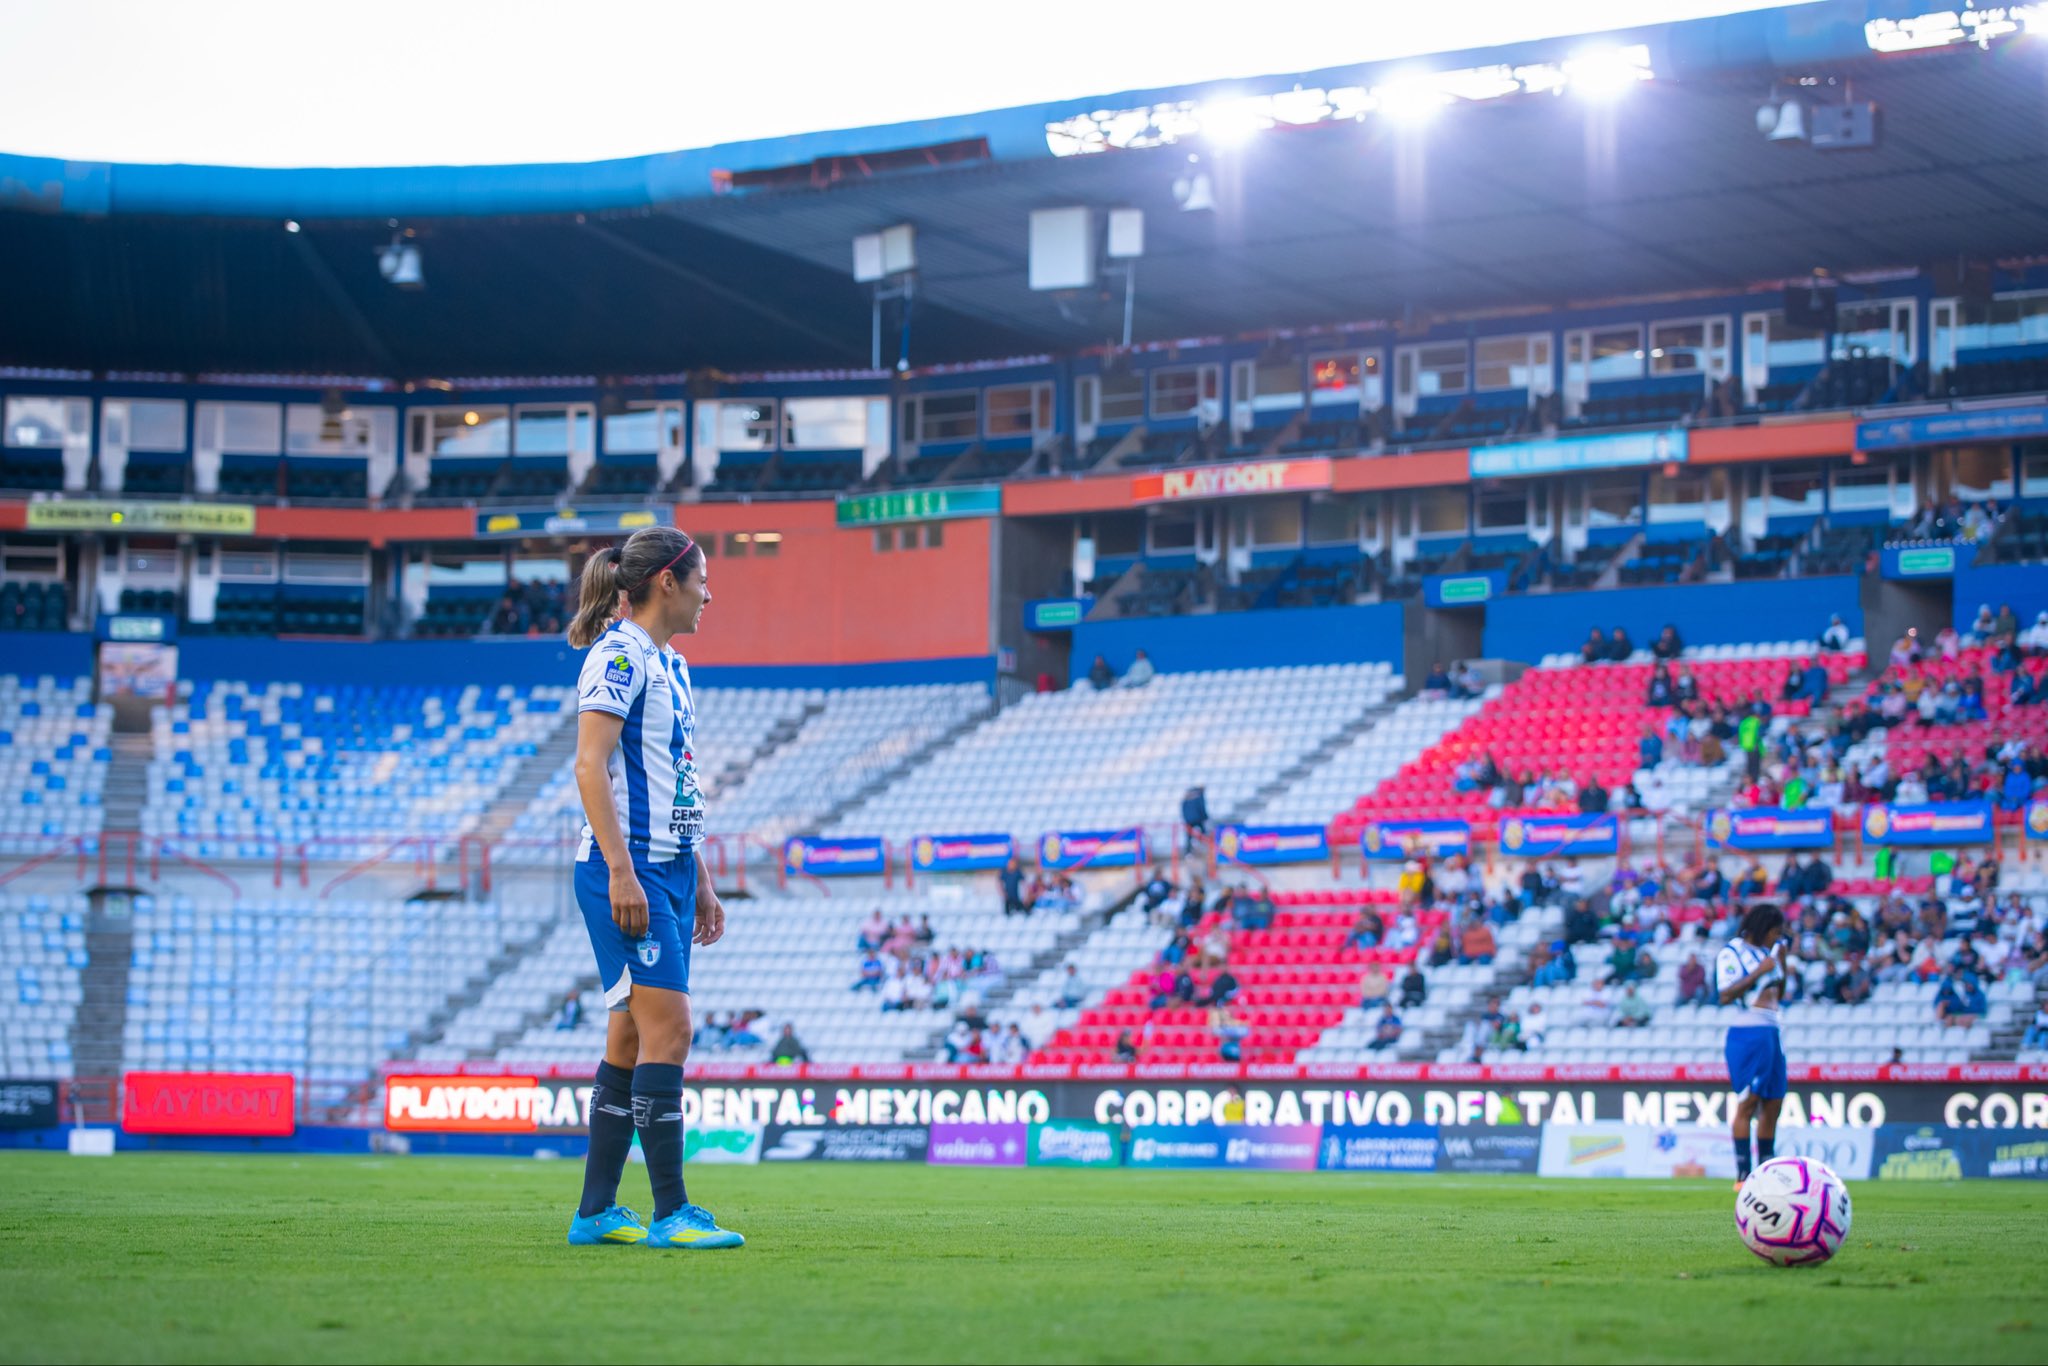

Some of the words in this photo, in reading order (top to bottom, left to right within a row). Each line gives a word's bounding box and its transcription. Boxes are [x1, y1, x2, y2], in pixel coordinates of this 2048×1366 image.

[1163, 463, 1288, 498] PLAYDOIT
[606, 671, 630, 685] BBVA
[389, 1086, 533, 1119] PLAYDOIT
[835, 1088, 1051, 1126] MEXICANO
[1622, 1091, 1886, 1129] MEXIANO
[933, 1137, 996, 1160] volaris
